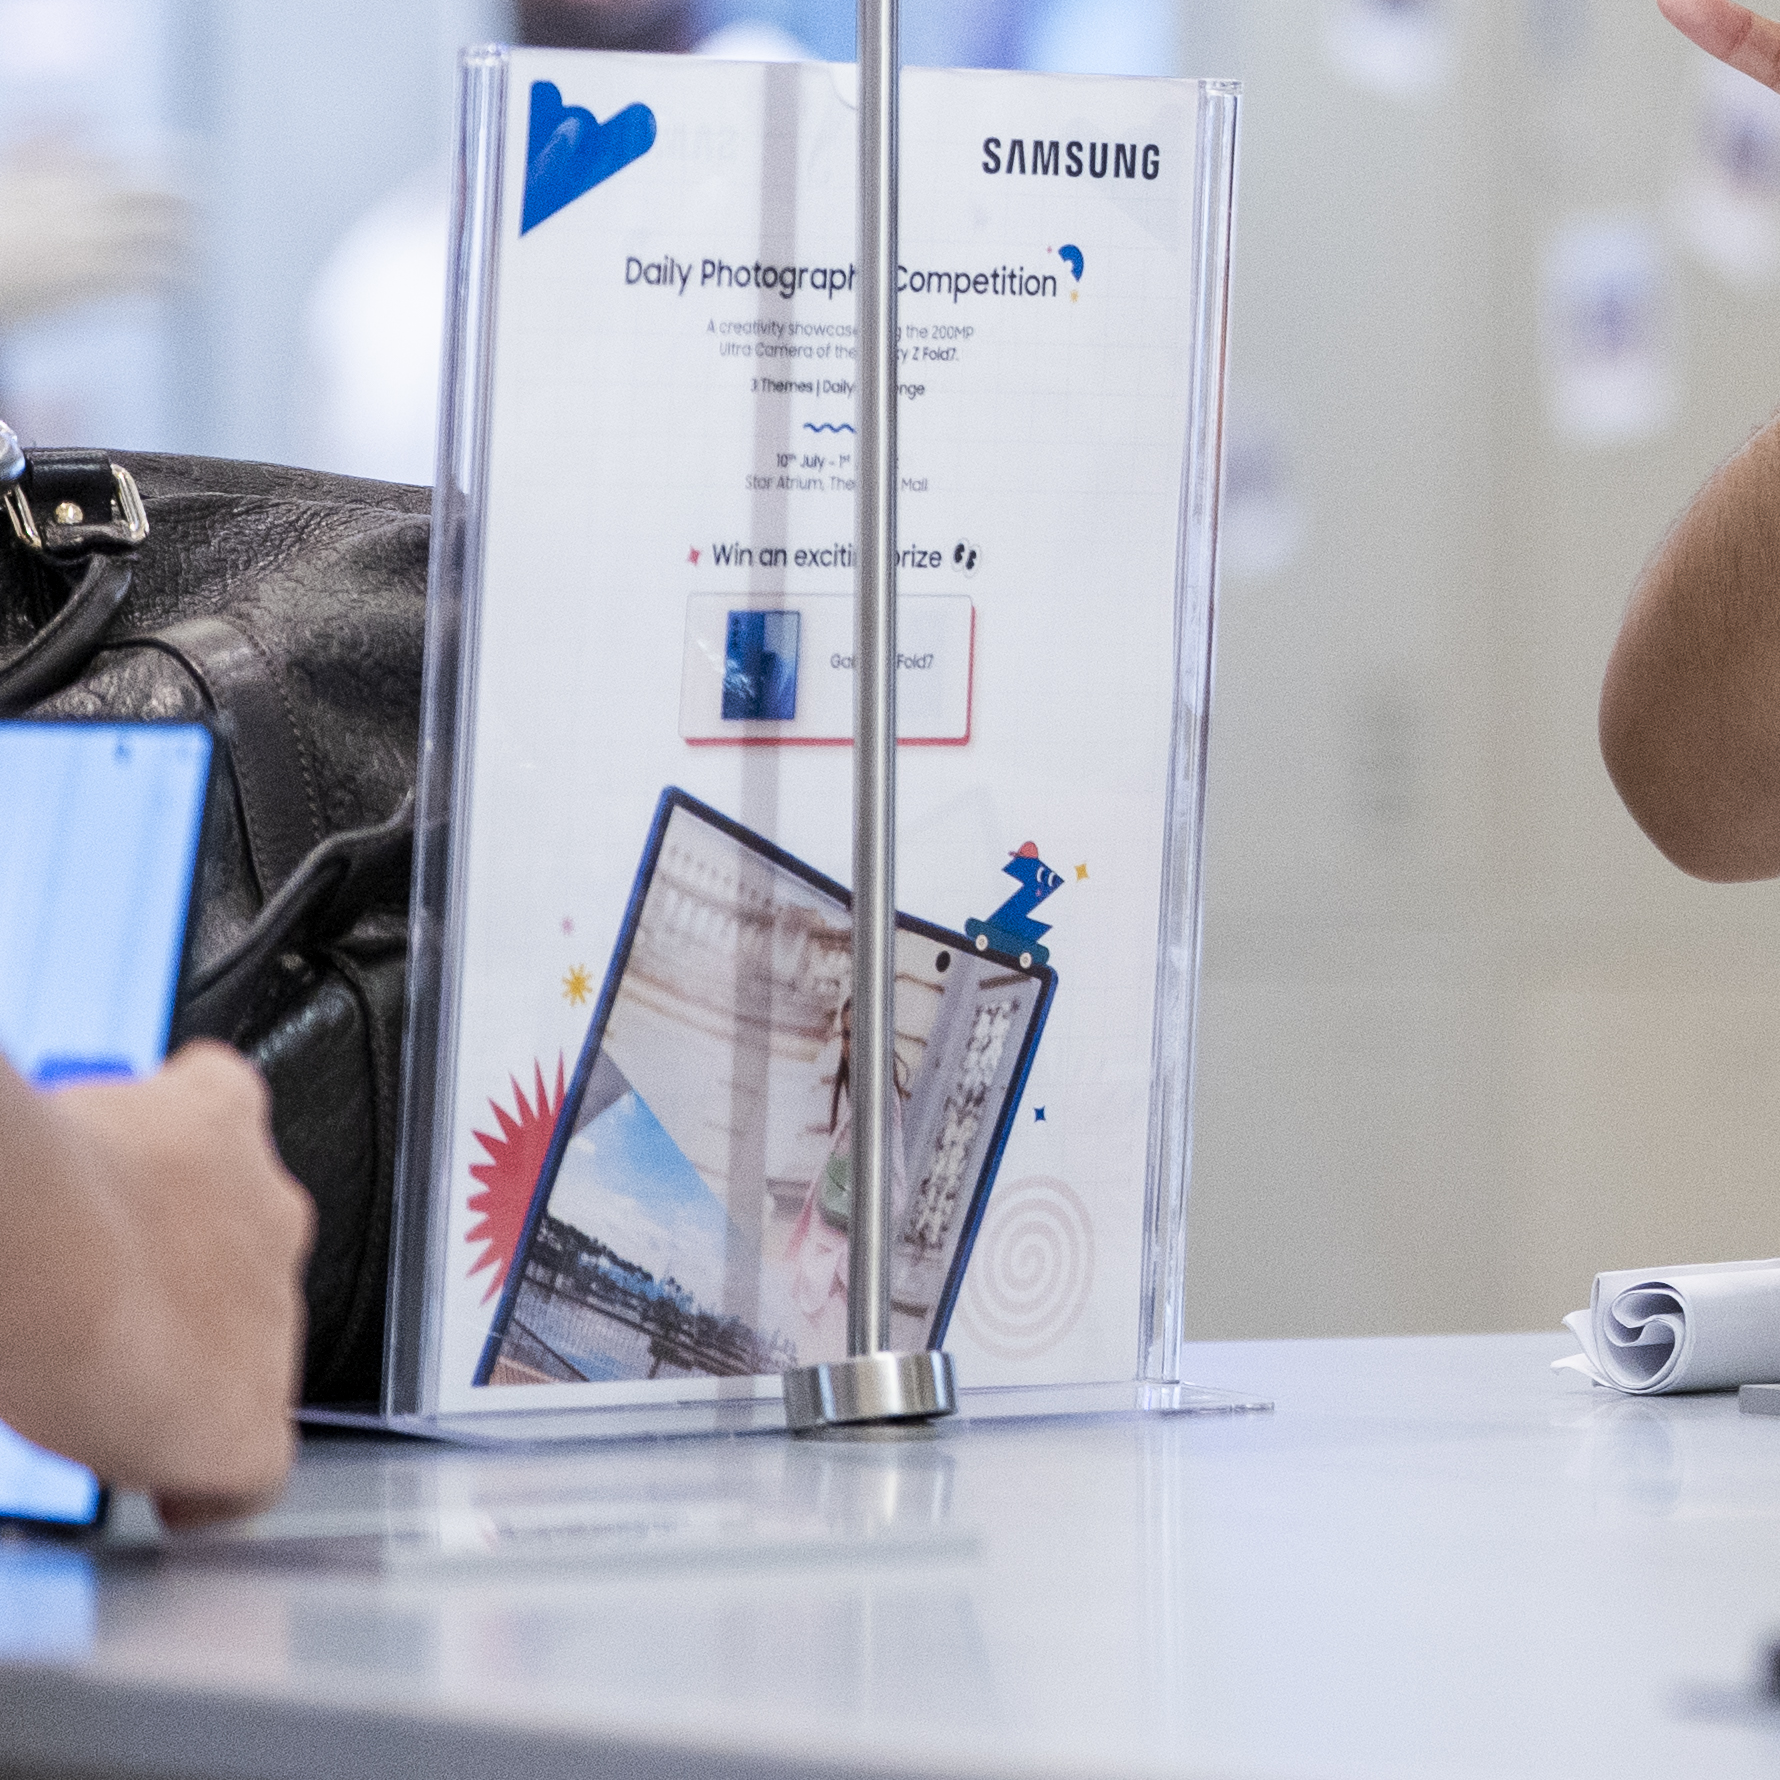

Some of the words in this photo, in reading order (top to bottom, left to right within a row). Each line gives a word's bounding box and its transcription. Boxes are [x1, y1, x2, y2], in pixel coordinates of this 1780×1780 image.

[981, 136, 1161, 181] SAMSUNG
[625, 255, 692, 296] Daily
[706, 318, 715, 334] A
[719, 319, 785, 340] creativity
[906, 324, 928, 339] the
[932, 324, 974, 340] 200MP
[719, 342, 752, 357] Ultra
[755, 341, 813, 359] Camera
[816, 342, 832, 358] of
[834, 343, 858, 359] the
[912, 346, 920, 361] Z
[761, 377, 813, 393] Themes
[822, 379, 855, 399] Daily
[800, 452, 825, 473] July
[712, 541, 753, 567] Win
[759, 545, 787, 567] an
[794, 541, 857, 569] exciti
